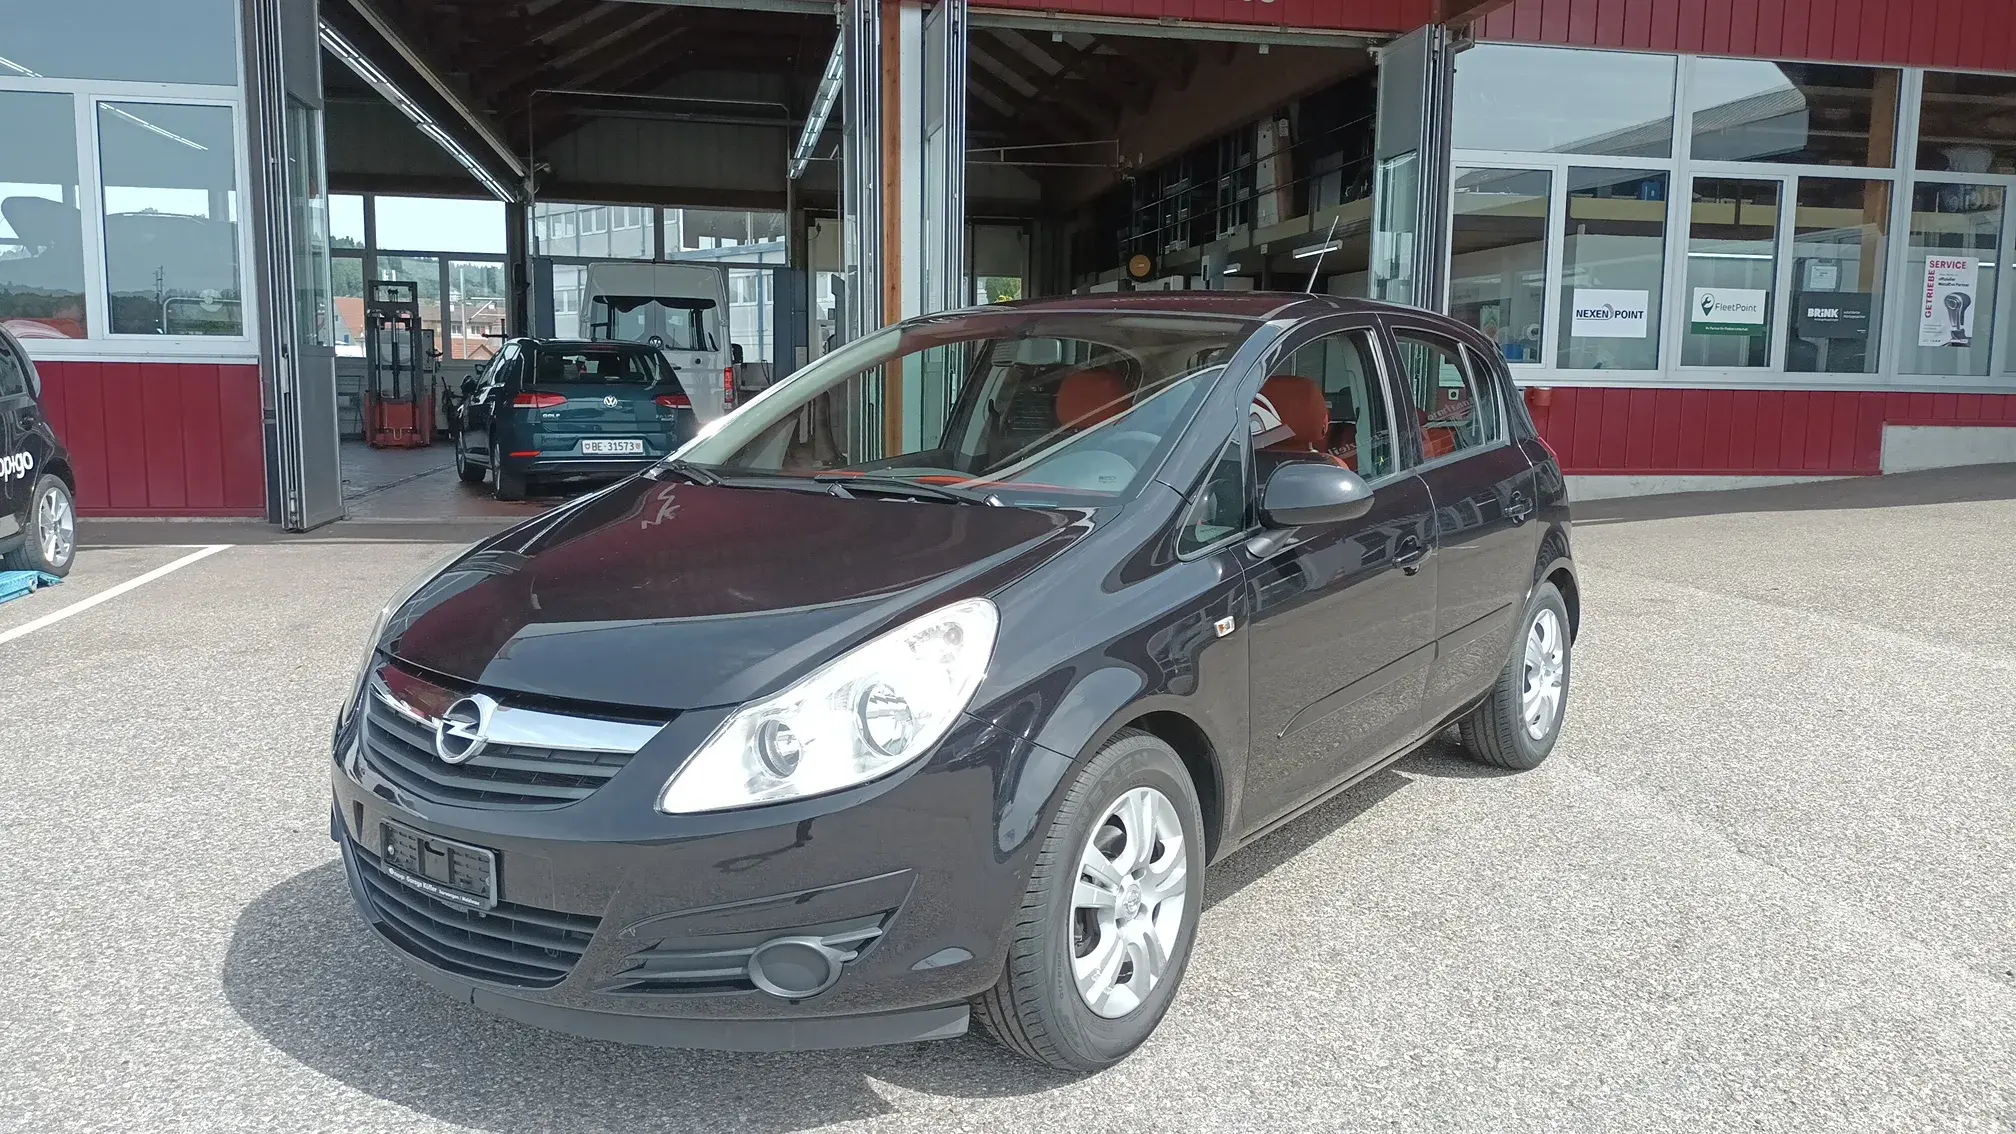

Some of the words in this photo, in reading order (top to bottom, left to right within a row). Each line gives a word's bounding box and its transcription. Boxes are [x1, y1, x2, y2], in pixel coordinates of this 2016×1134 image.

[1929, 260, 1967, 269] SERVICE
[1924, 269, 1936, 318] GETRIEBE
[1715, 303, 1757, 313] FleetPoint
[1576, 309, 1609, 318] NEXEN
[1614, 310, 1644, 319] POINT
